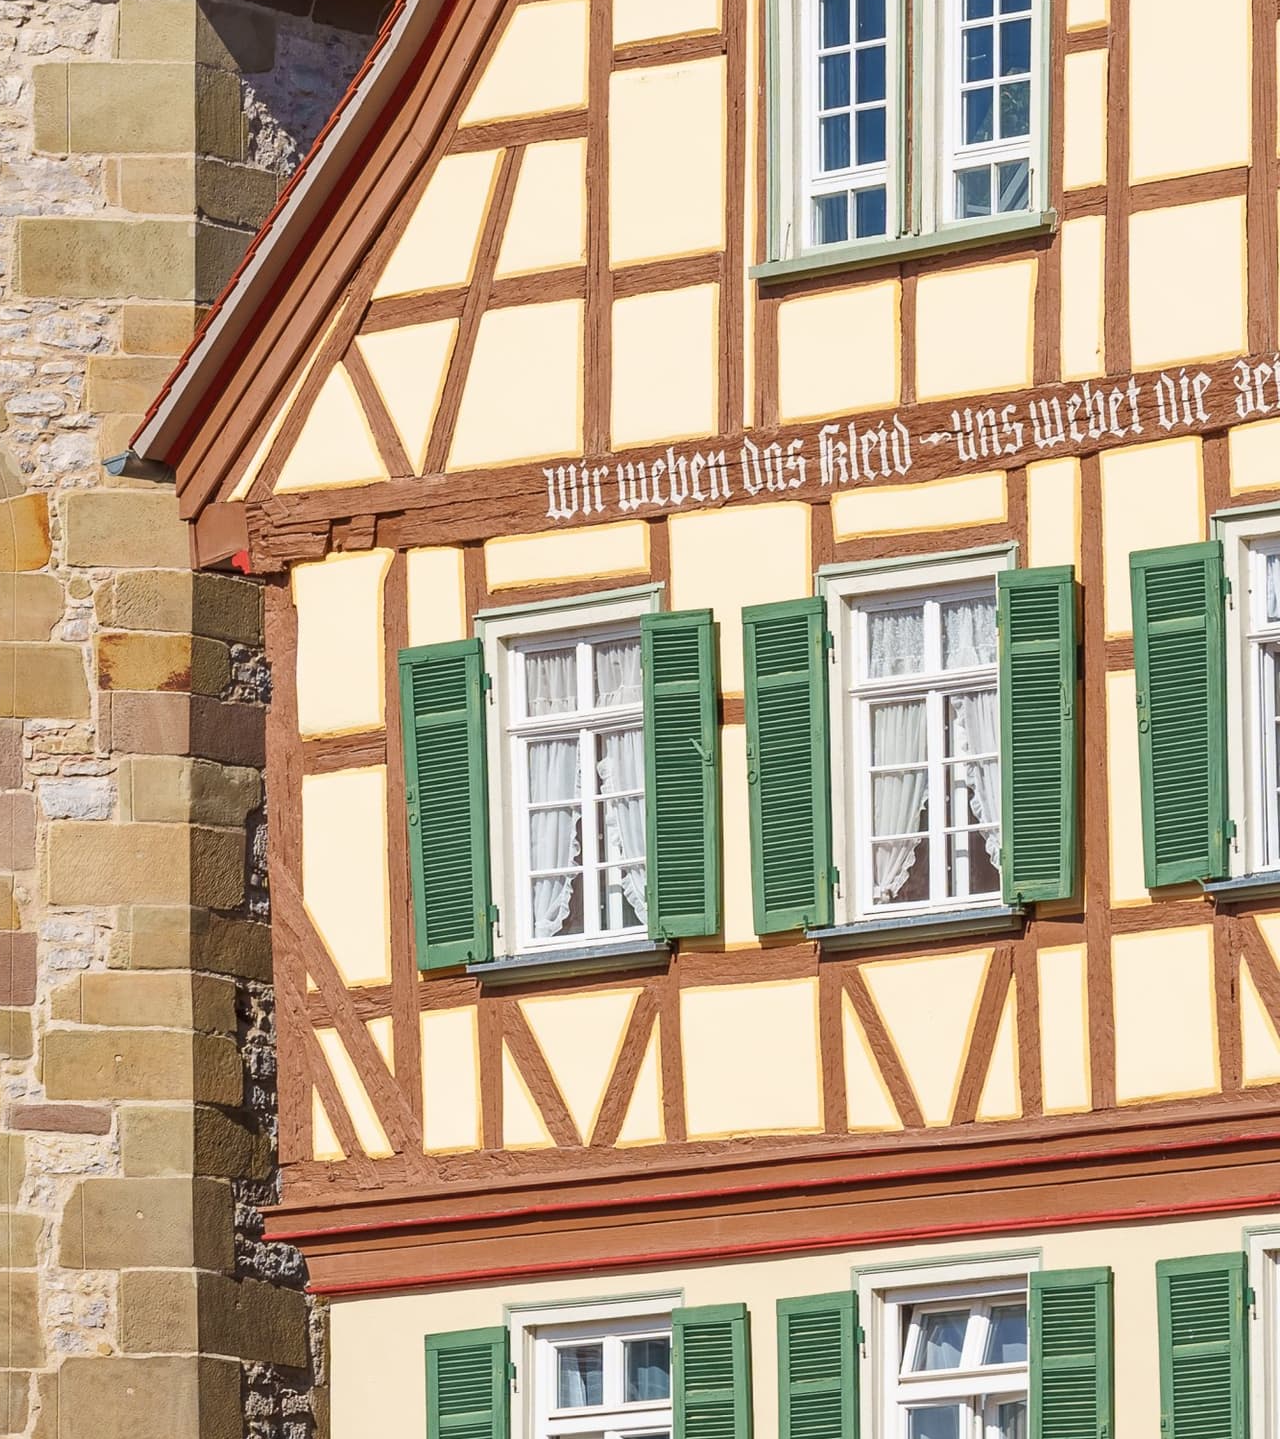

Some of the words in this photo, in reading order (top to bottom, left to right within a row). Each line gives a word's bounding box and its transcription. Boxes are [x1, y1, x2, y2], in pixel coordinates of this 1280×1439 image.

[616, 447, 734, 511] weben
[740, 436, 807, 496] das
[1029, 377, 1144, 449] webet
[1154, 368, 1213, 431] die
